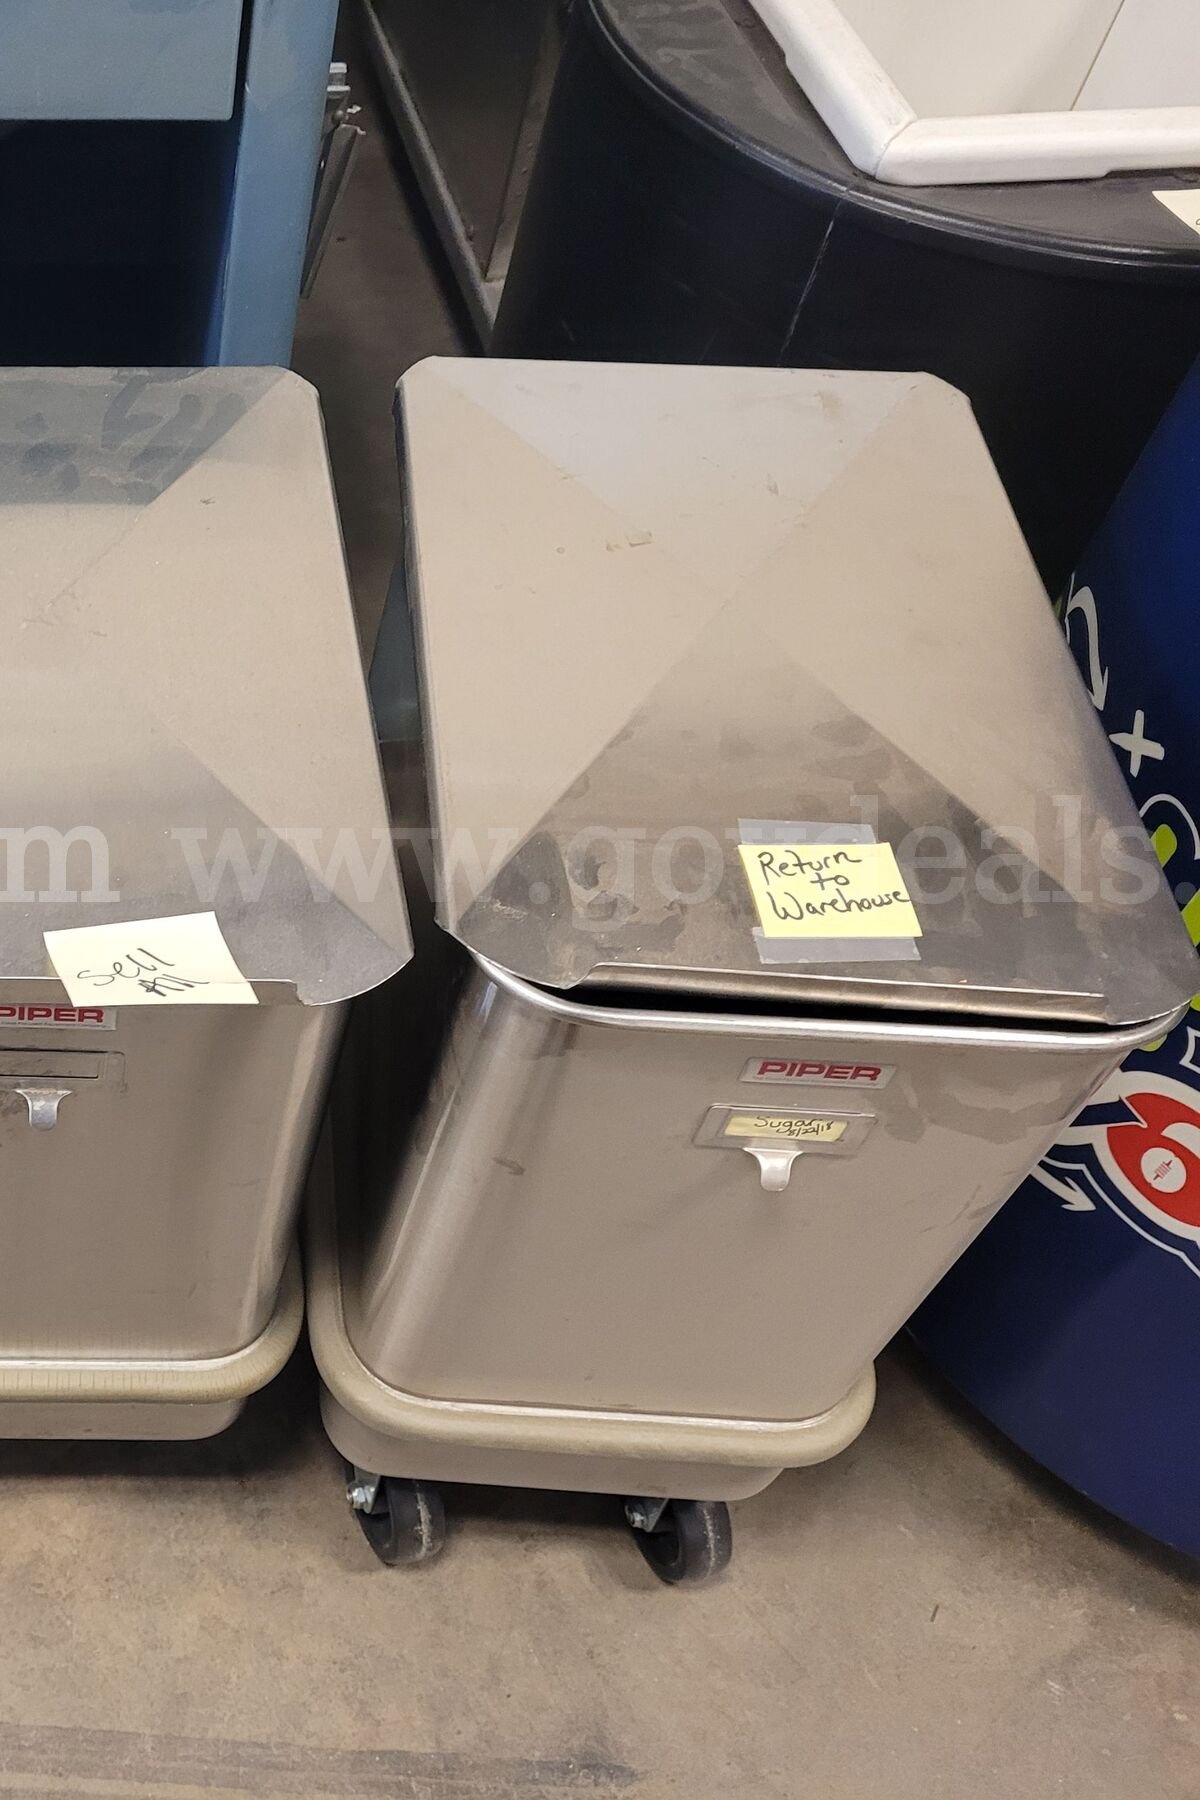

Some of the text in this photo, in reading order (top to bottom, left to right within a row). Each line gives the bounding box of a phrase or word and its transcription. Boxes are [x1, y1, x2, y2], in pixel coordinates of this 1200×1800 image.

[757, 850, 863, 886] Return
[810, 872, 850, 891] to
[766, 888, 911, 920] Warehouse
[757, 1061, 881, 1081] PIPER
